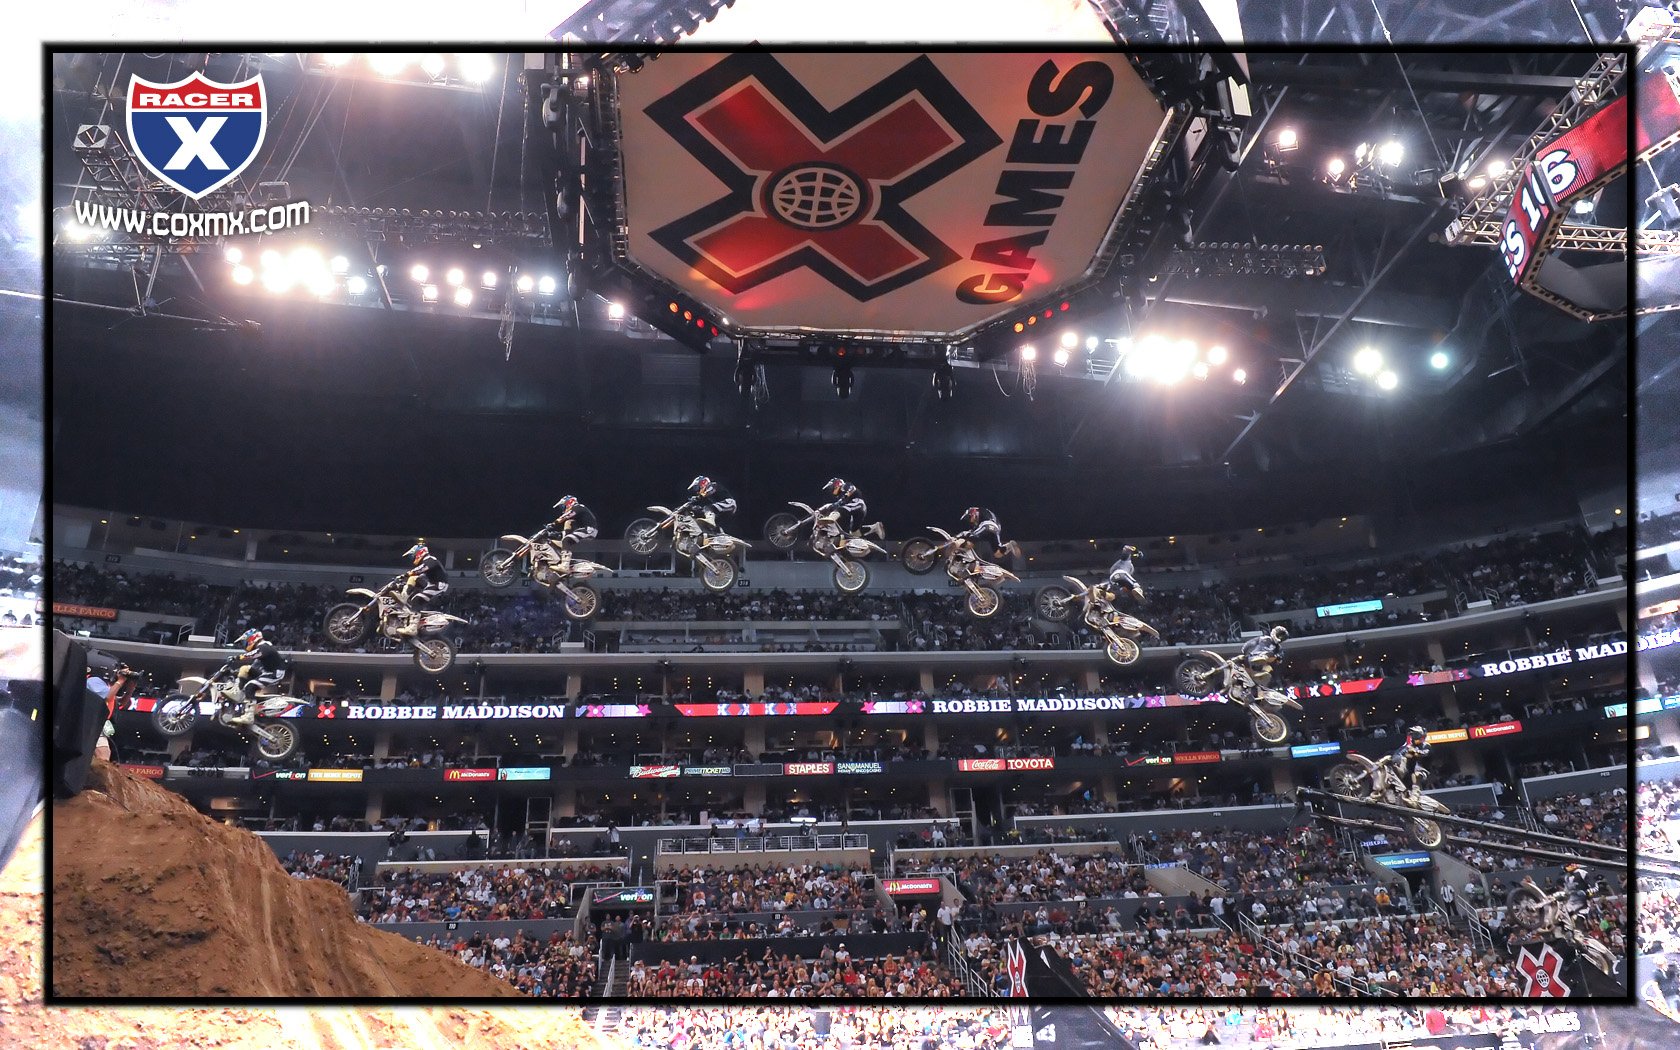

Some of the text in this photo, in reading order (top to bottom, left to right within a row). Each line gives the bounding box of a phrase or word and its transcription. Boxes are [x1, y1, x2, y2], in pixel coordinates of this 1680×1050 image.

[956, 59, 1115, 305] GAMES
[80, 607, 115, 618] FARGO
[1482, 649, 1572, 677] ROBBIE
[932, 697, 1125, 713] ROBBIE MADDISON
[347, 705, 565, 719] ROBBIE MADDISON
[1486, 725, 1515, 733] McDonald's
[1007, 758, 1053, 769] TOYOTA
[1145, 755, 1172, 764] verizon
[631, 765, 676, 778] Budweiser
[788, 763, 830, 775] STAPLES
[837, 762, 850, 770] SAN
[136, 768, 164, 776] FARGO
[275, 771, 306, 780] verizon
[1405, 857, 1431, 865] Express
[620, 892, 653, 902] verizon
